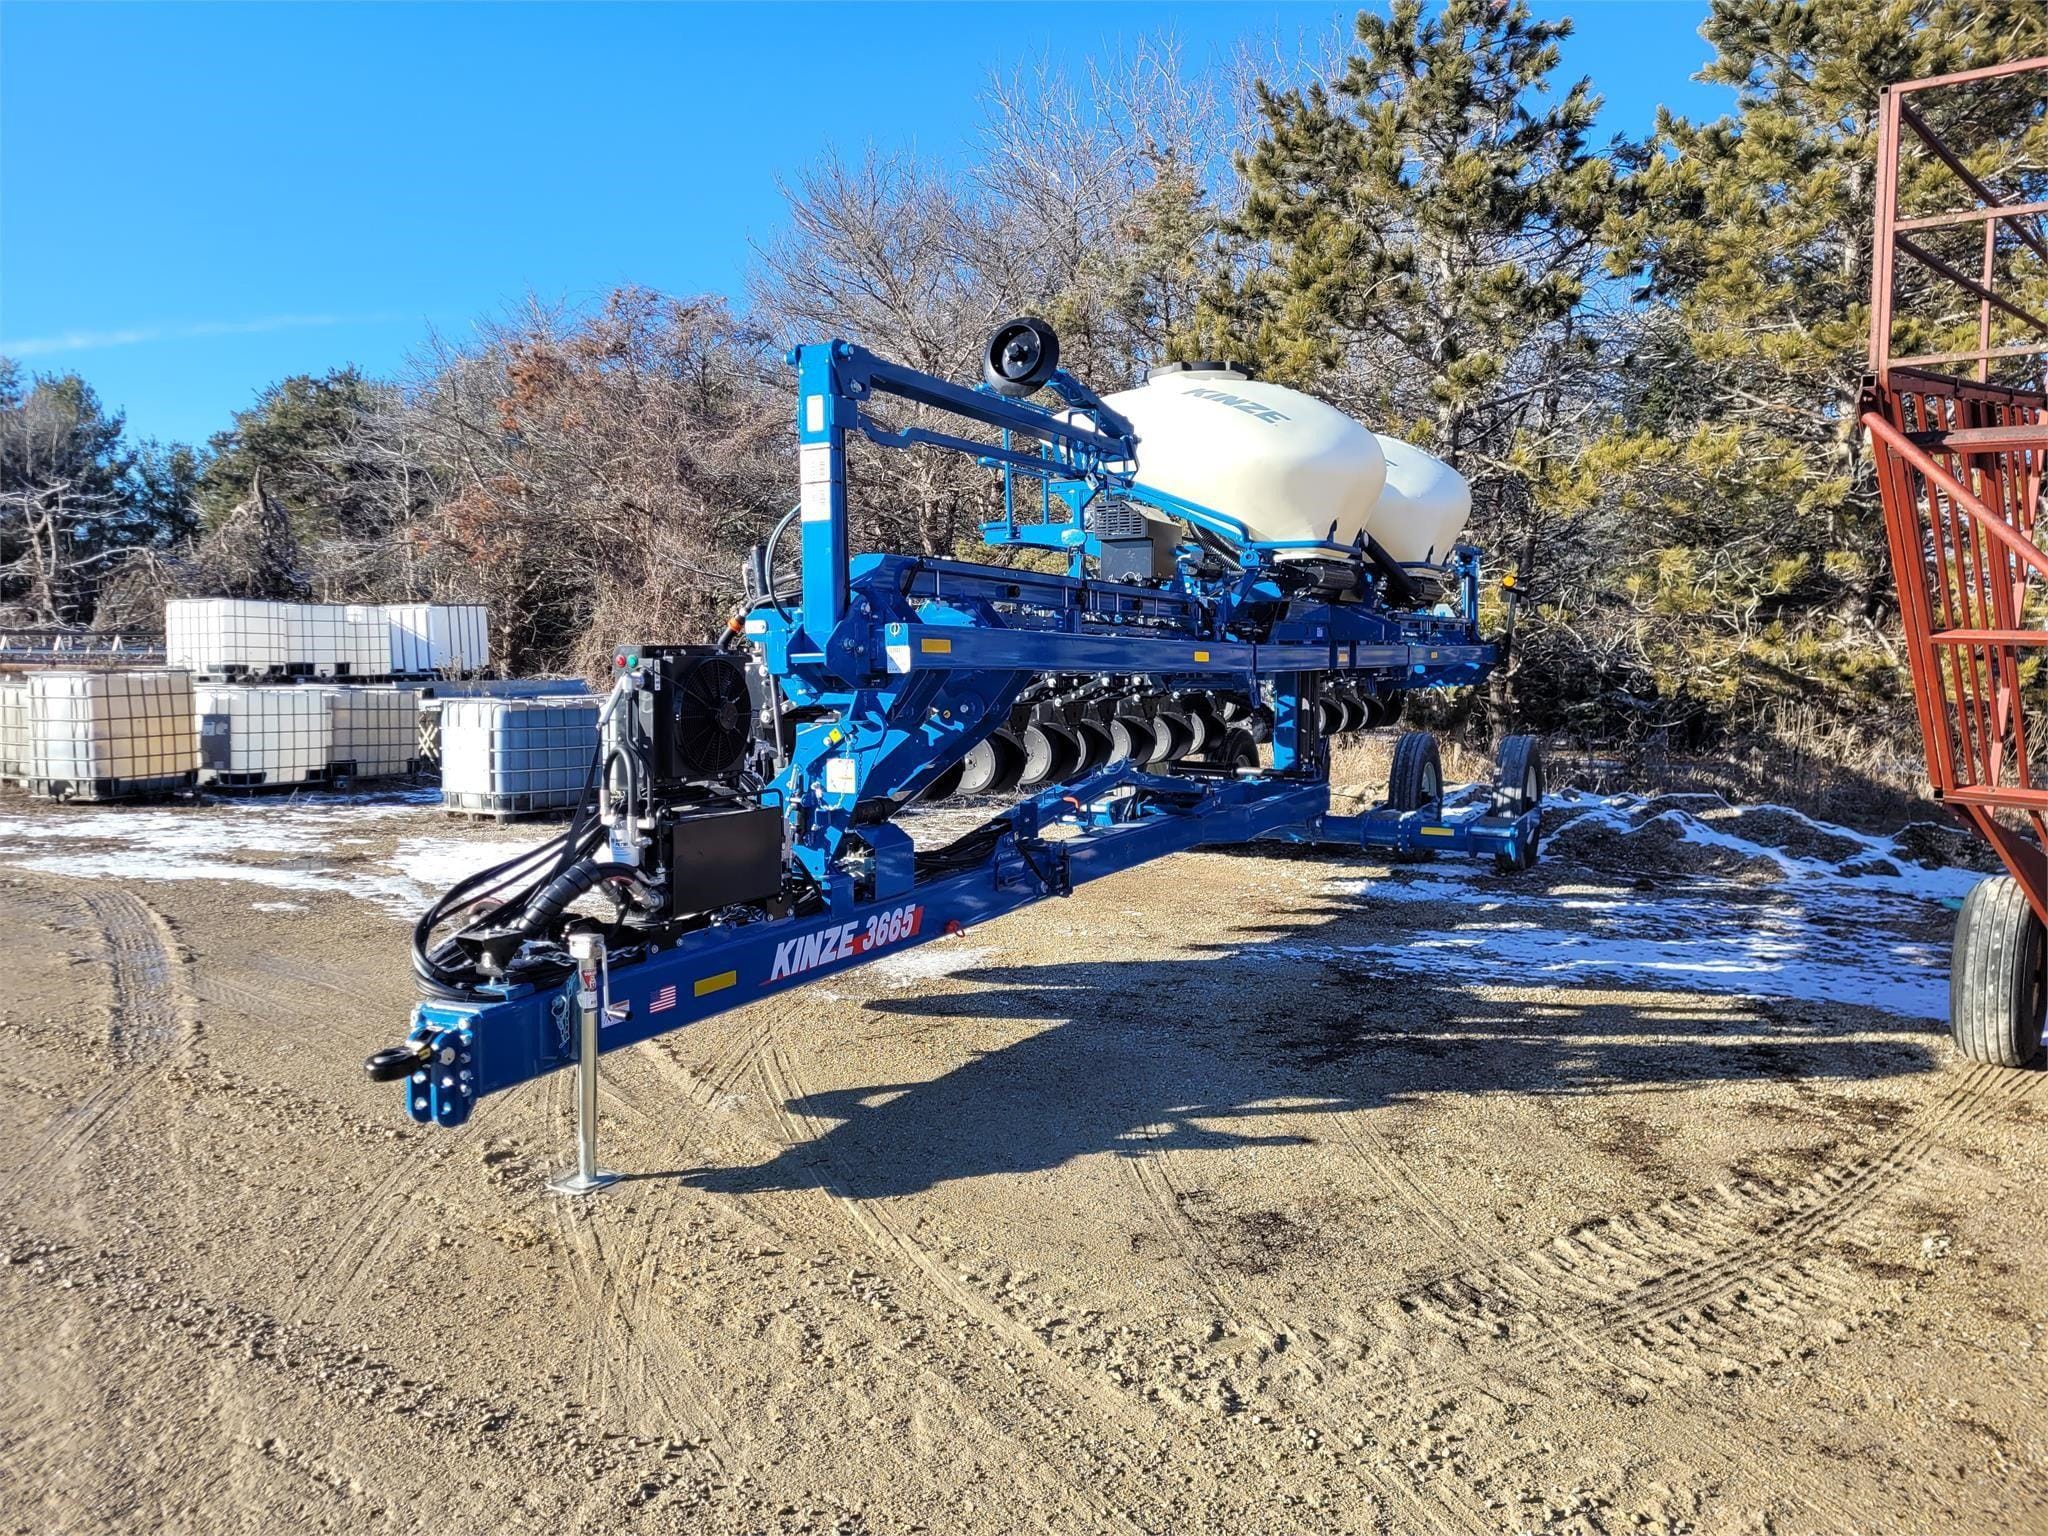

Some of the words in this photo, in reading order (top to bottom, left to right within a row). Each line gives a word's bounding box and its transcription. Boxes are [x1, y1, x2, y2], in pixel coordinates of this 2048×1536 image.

[1179, 388, 1291, 424] KINZE
[770, 920, 859, 981] KINZE
[862, 903, 916, 951] 3665
